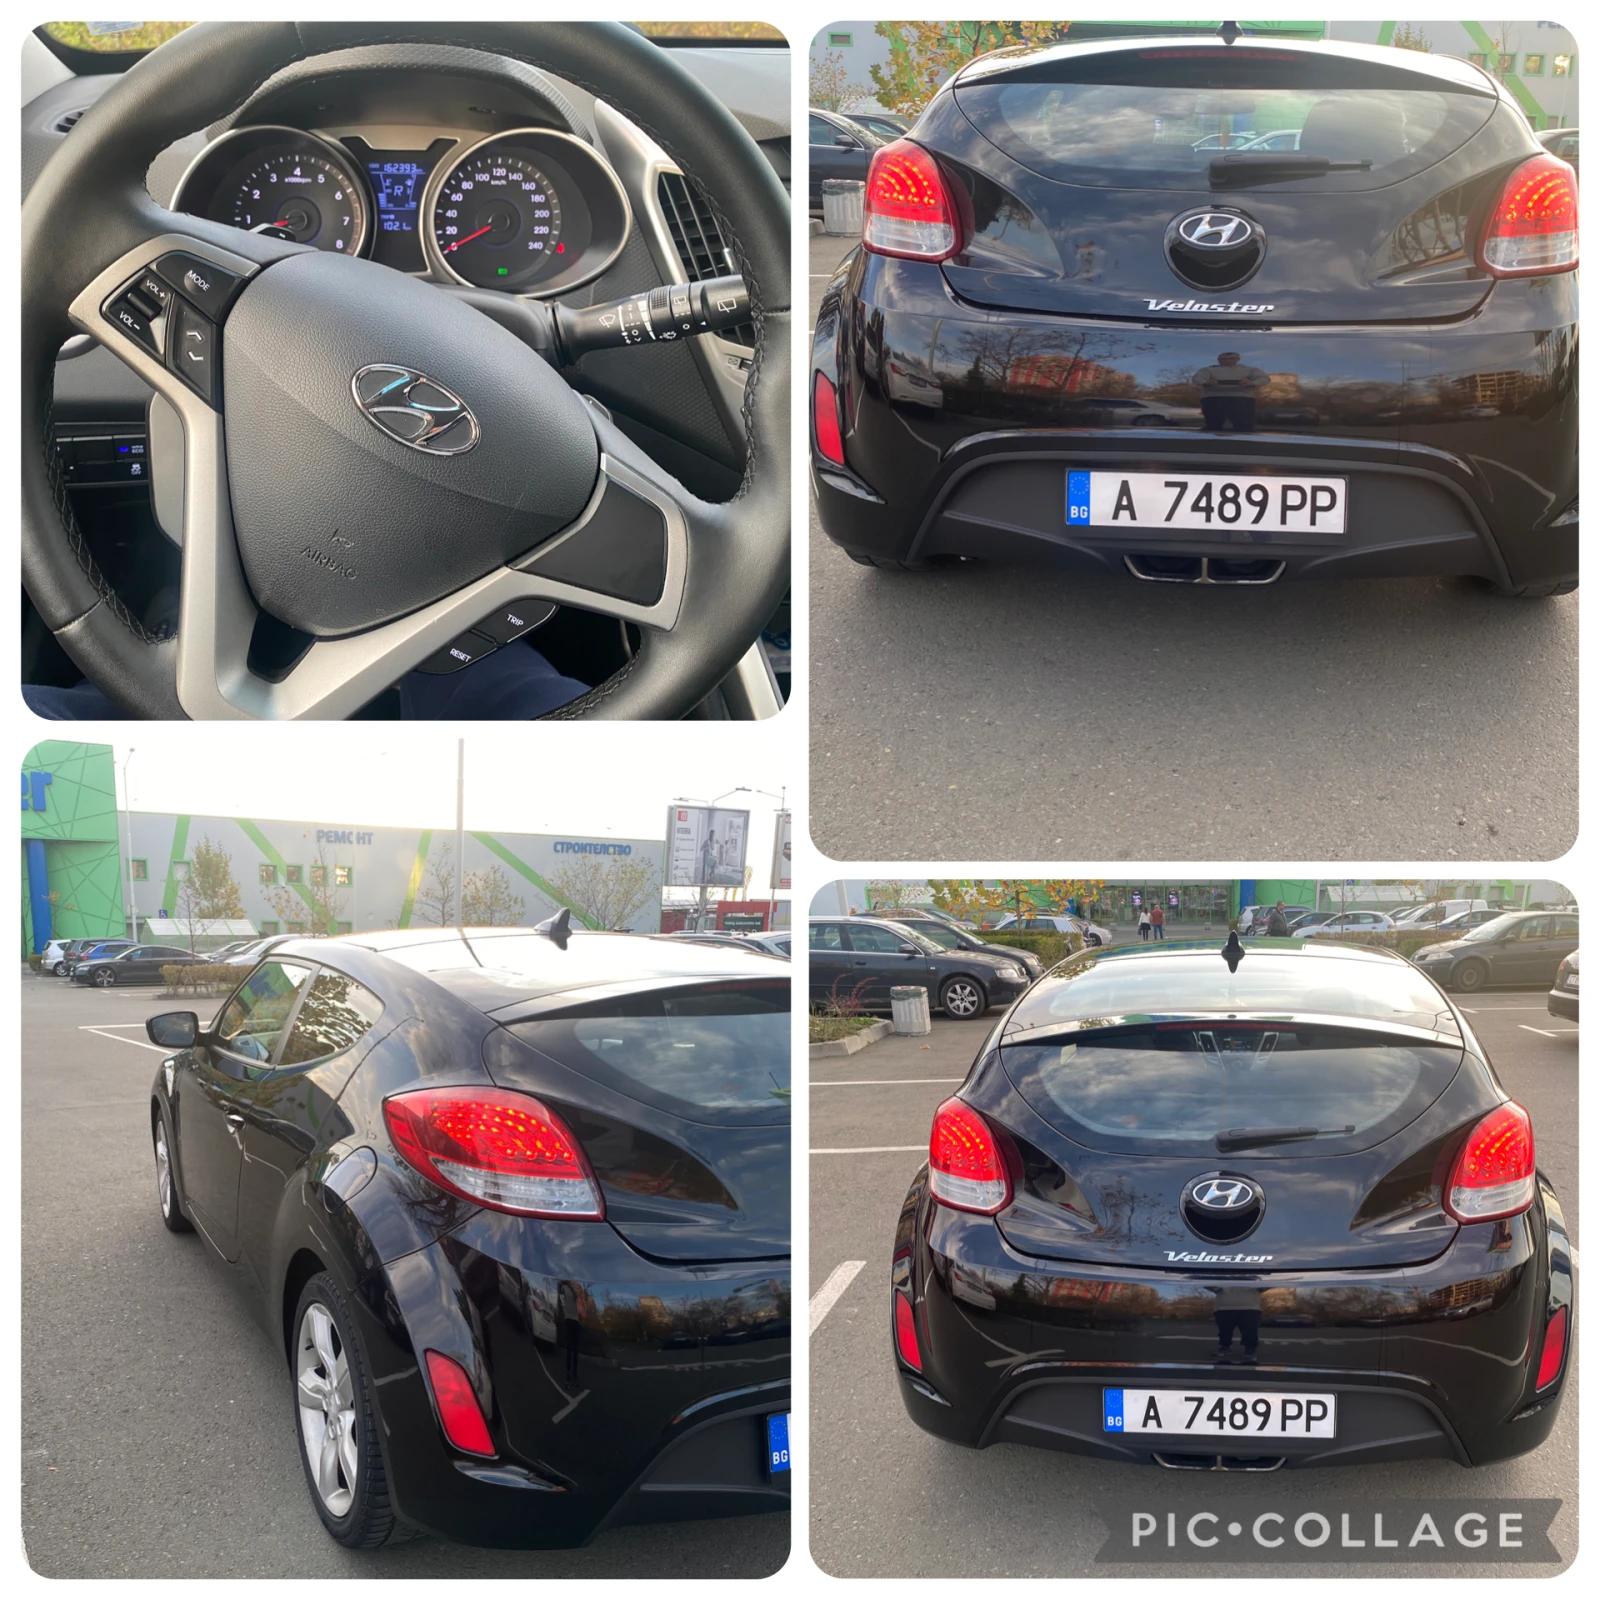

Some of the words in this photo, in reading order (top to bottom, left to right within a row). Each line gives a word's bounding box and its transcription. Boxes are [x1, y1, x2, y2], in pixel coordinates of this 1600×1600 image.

[293, 167, 301, 176] 4
[383, 163, 417, 173] 162393
[492, 167, 507, 176] 120
[269, 173, 277, 182] 3
[317, 174, 325, 183] 5
[475, 173, 490, 182] 100
[508, 172, 523, 181] 140
[393, 185, 404, 196] R
[461, 181, 474, 190] 80
[521, 181, 536, 191] 160
[252, 189, 261, 199] 2
[334, 191, 343, 200] 6
[450, 193, 463, 202] 60
[530, 194, 545, 203] 180
[445, 209, 458, 218] 40
[534, 209, 550, 218] 200
[246, 215, 251, 224] 1
[342, 216, 350, 226] 7
[445, 226, 458, 235] 20
[533, 226, 549, 235] 220
[335, 239, 344, 249] 8
[528, 241, 543, 251] 240
[186, 269, 211, 292] MODE
[1142, 298, 1275, 314] Veloster
[1111, 479, 1137, 521] A
[1163, 480, 1270, 525] 7489
[1280, 484, 1337, 527] PP
[1070, 505, 1089, 519] BG
[300, 546, 357, 580] AIRBAG
[506, 613, 524, 627] TRIP
[449, 647, 472, 663] RESET
[553, 841, 632, 856] СТРОИТЕЛСТВО
[1163, 1250, 1274, 1263] Veloster
[1141, 1395, 1163, 1429] A
[1184, 1396, 1272, 1432] 7489
[1280, 1399, 1328, 1433] PP
[1107, 1415, 1123, 1427] BG
[772, 1449, 788, 1465] BG
